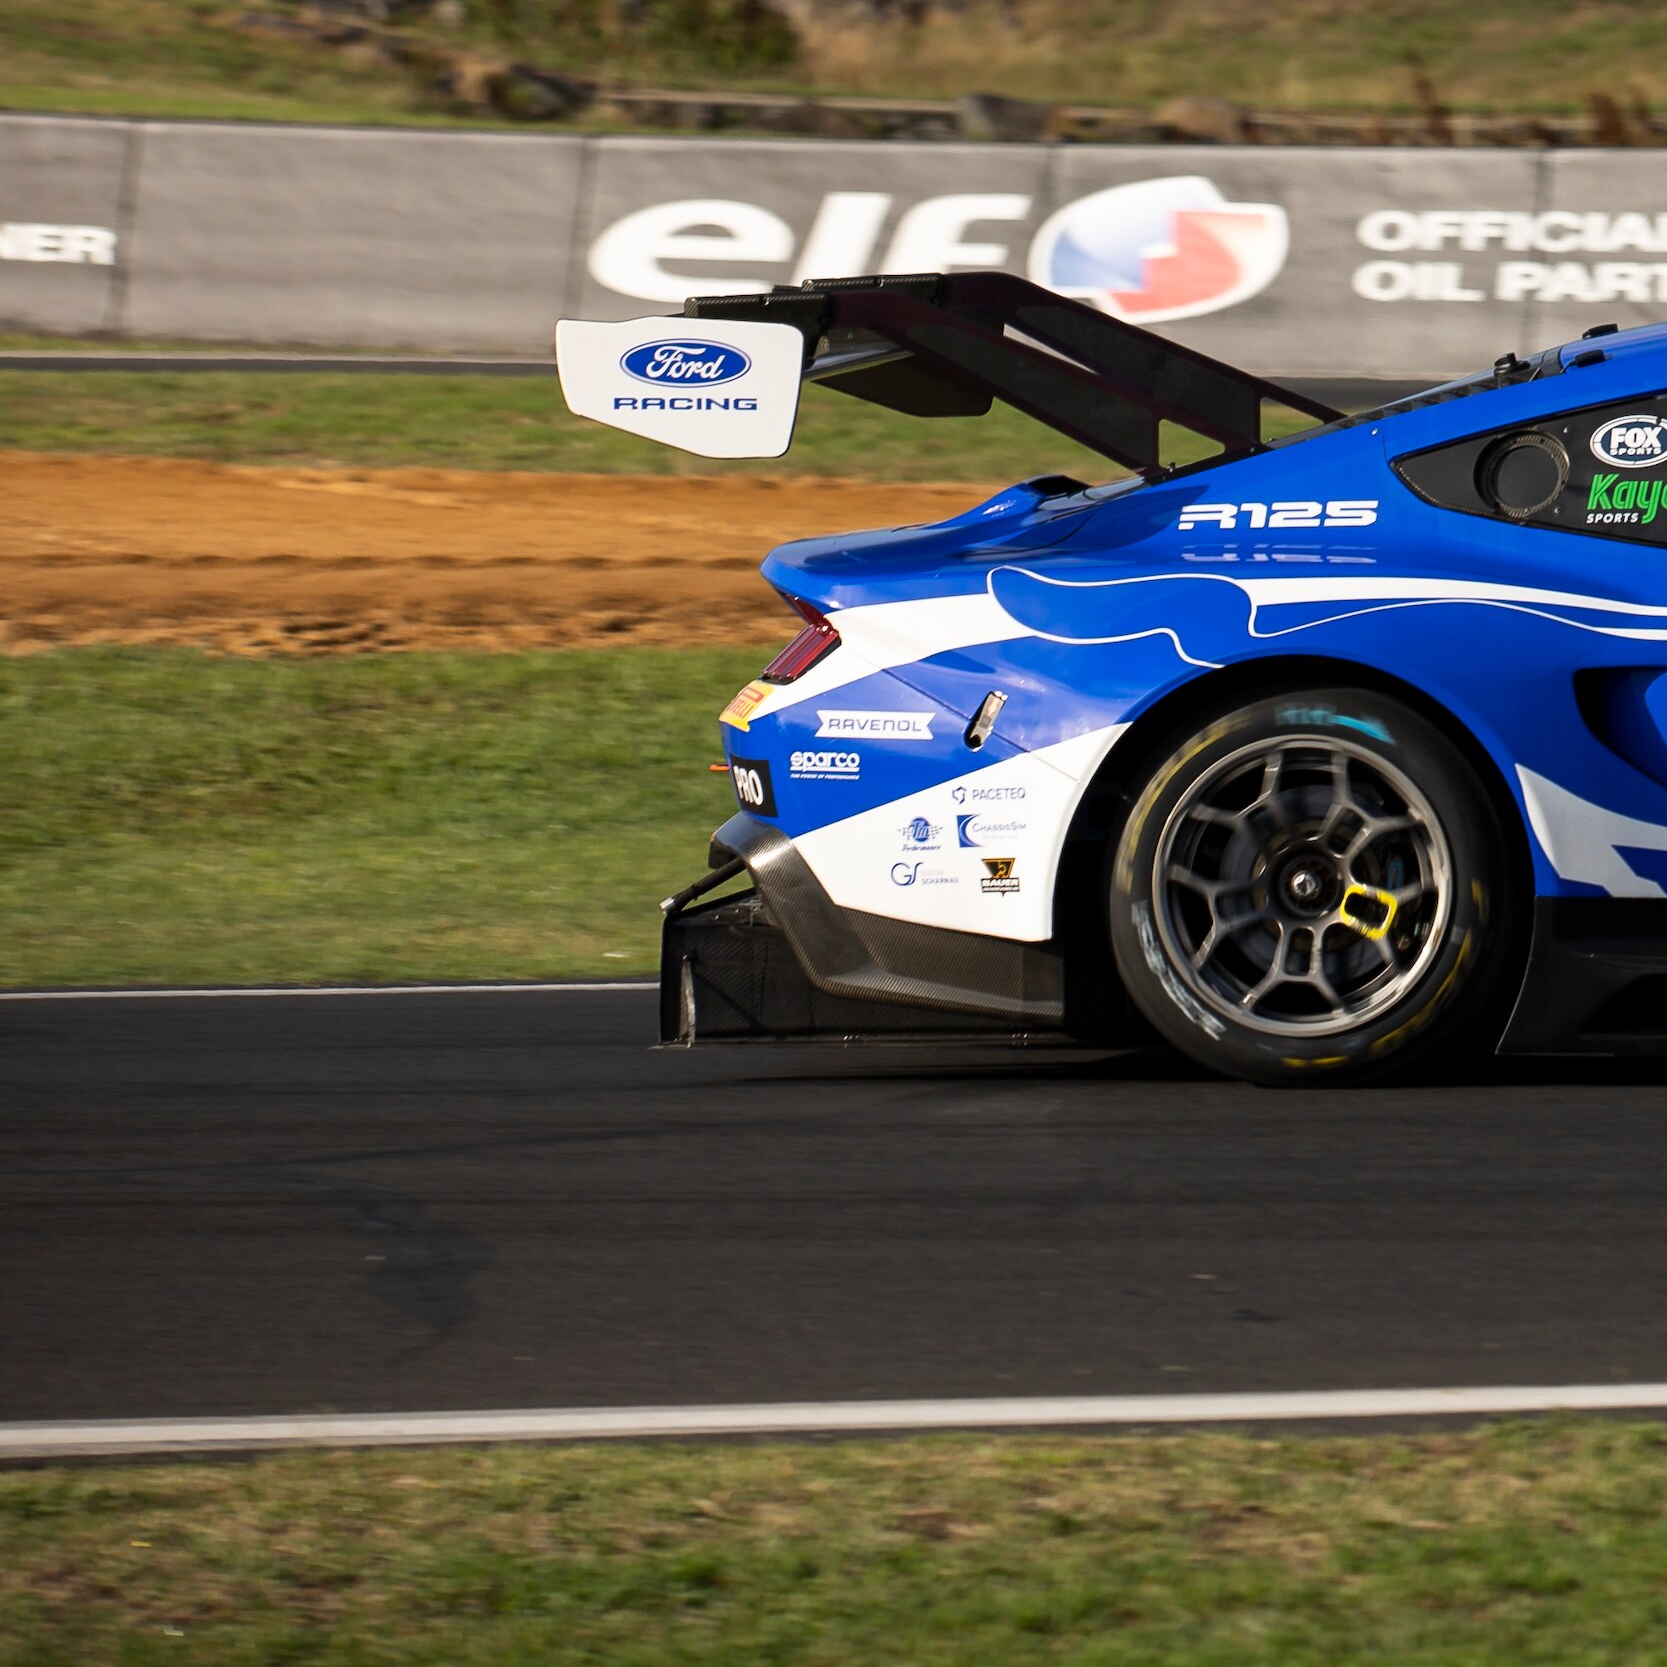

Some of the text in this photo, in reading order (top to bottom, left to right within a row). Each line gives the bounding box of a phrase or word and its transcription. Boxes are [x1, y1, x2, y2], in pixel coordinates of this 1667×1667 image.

[589, 191, 1031, 303] elf
[1352, 260, 1487, 303] OIL
[643, 343, 729, 381] Ford
[613, 396, 757, 412] RACING
[1609, 428, 1661, 450] FOX
[1609, 446, 1662, 457] SPORTS
[1178, 499, 1379, 532] R125
[1586, 512, 1639, 524] SPORTS
[827, 717, 924, 732] RAVENOL
[790, 750, 860, 772] sparco
[733, 762, 765, 807] PRO
